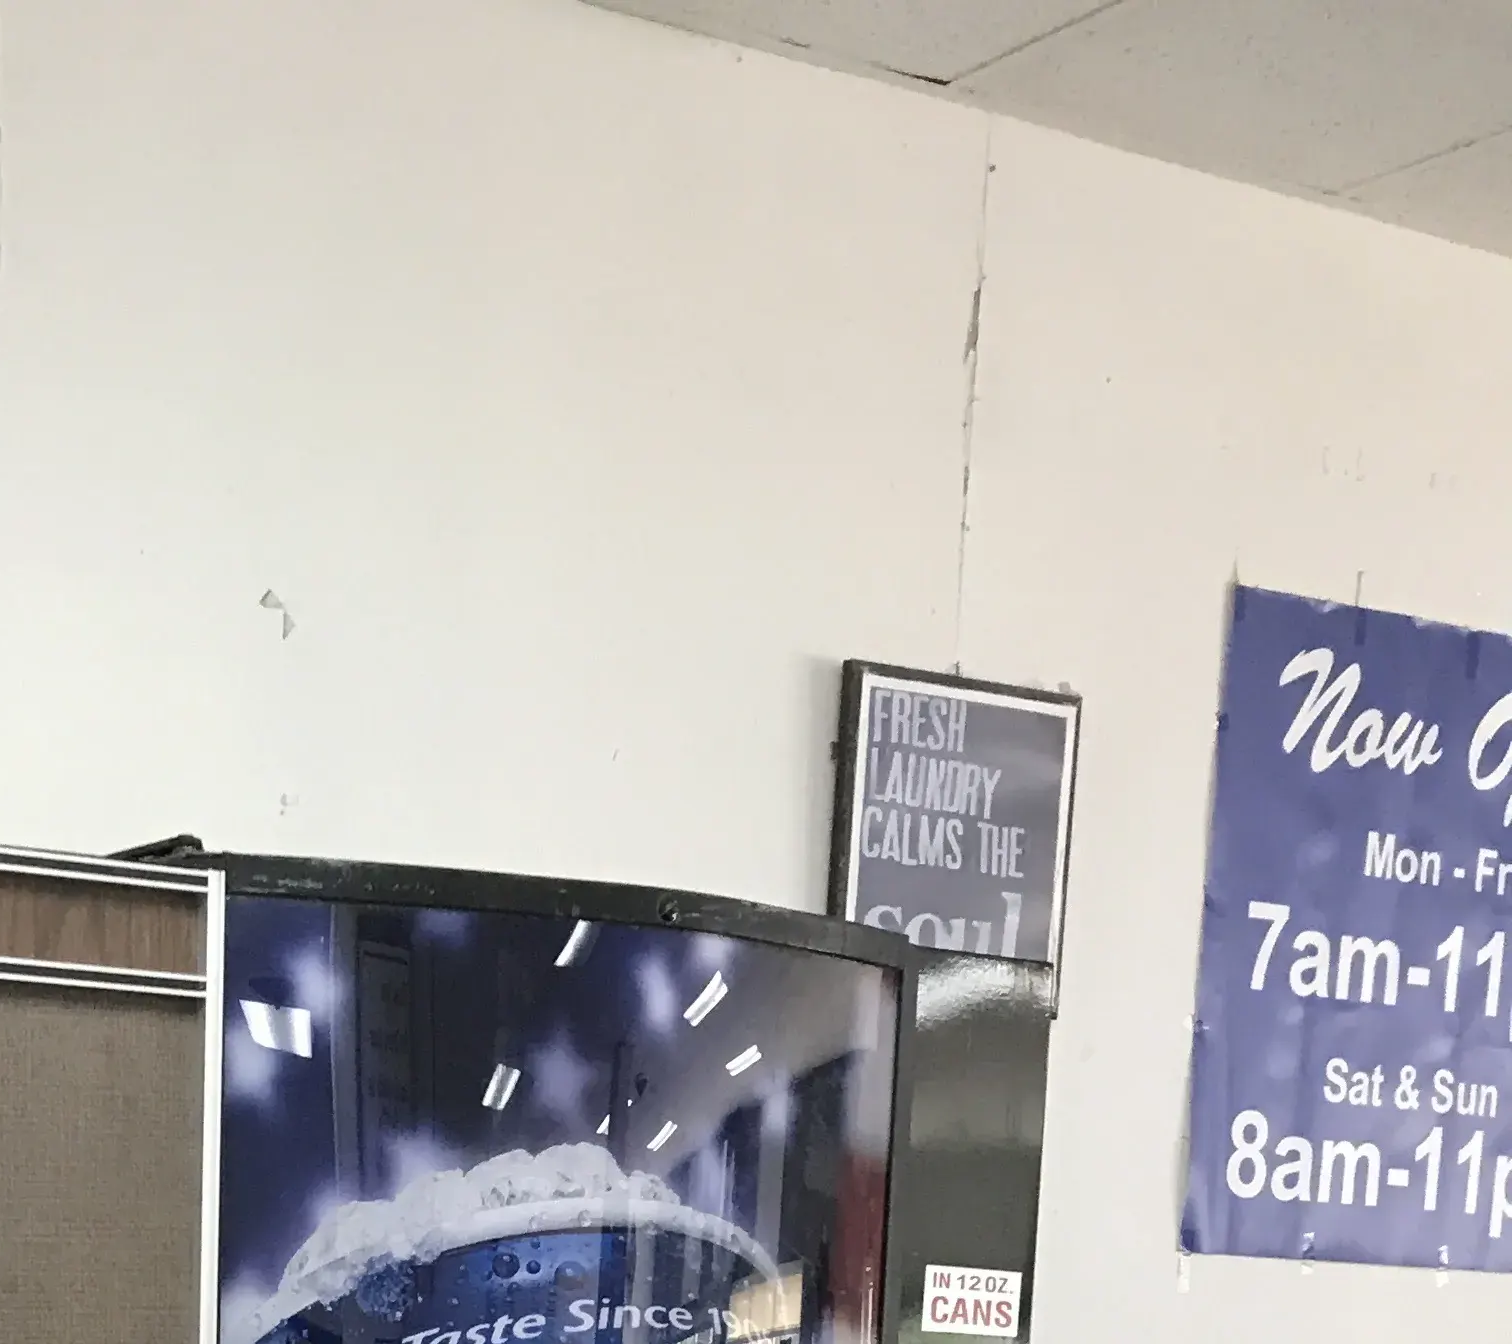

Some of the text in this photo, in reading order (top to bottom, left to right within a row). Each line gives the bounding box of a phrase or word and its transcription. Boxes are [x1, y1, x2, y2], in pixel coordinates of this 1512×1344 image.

[872, 689, 968, 752] FRESH
[1279, 648, 1512, 828] Now O
[869, 747, 1002, 820] LAUNDRY
[862, 805, 1025, 879] CALMS THE
[1363, 830, 1441, 886] Mon
[1247, 900, 1512, 1041] 7am-11
[1323, 1058, 1498, 1119] Sat & Sun
[930, 1296, 1013, 1328] CANS
[933, 1272, 1014, 1294] IN 12 OZ.
[563, 1297, 694, 1334] Since
